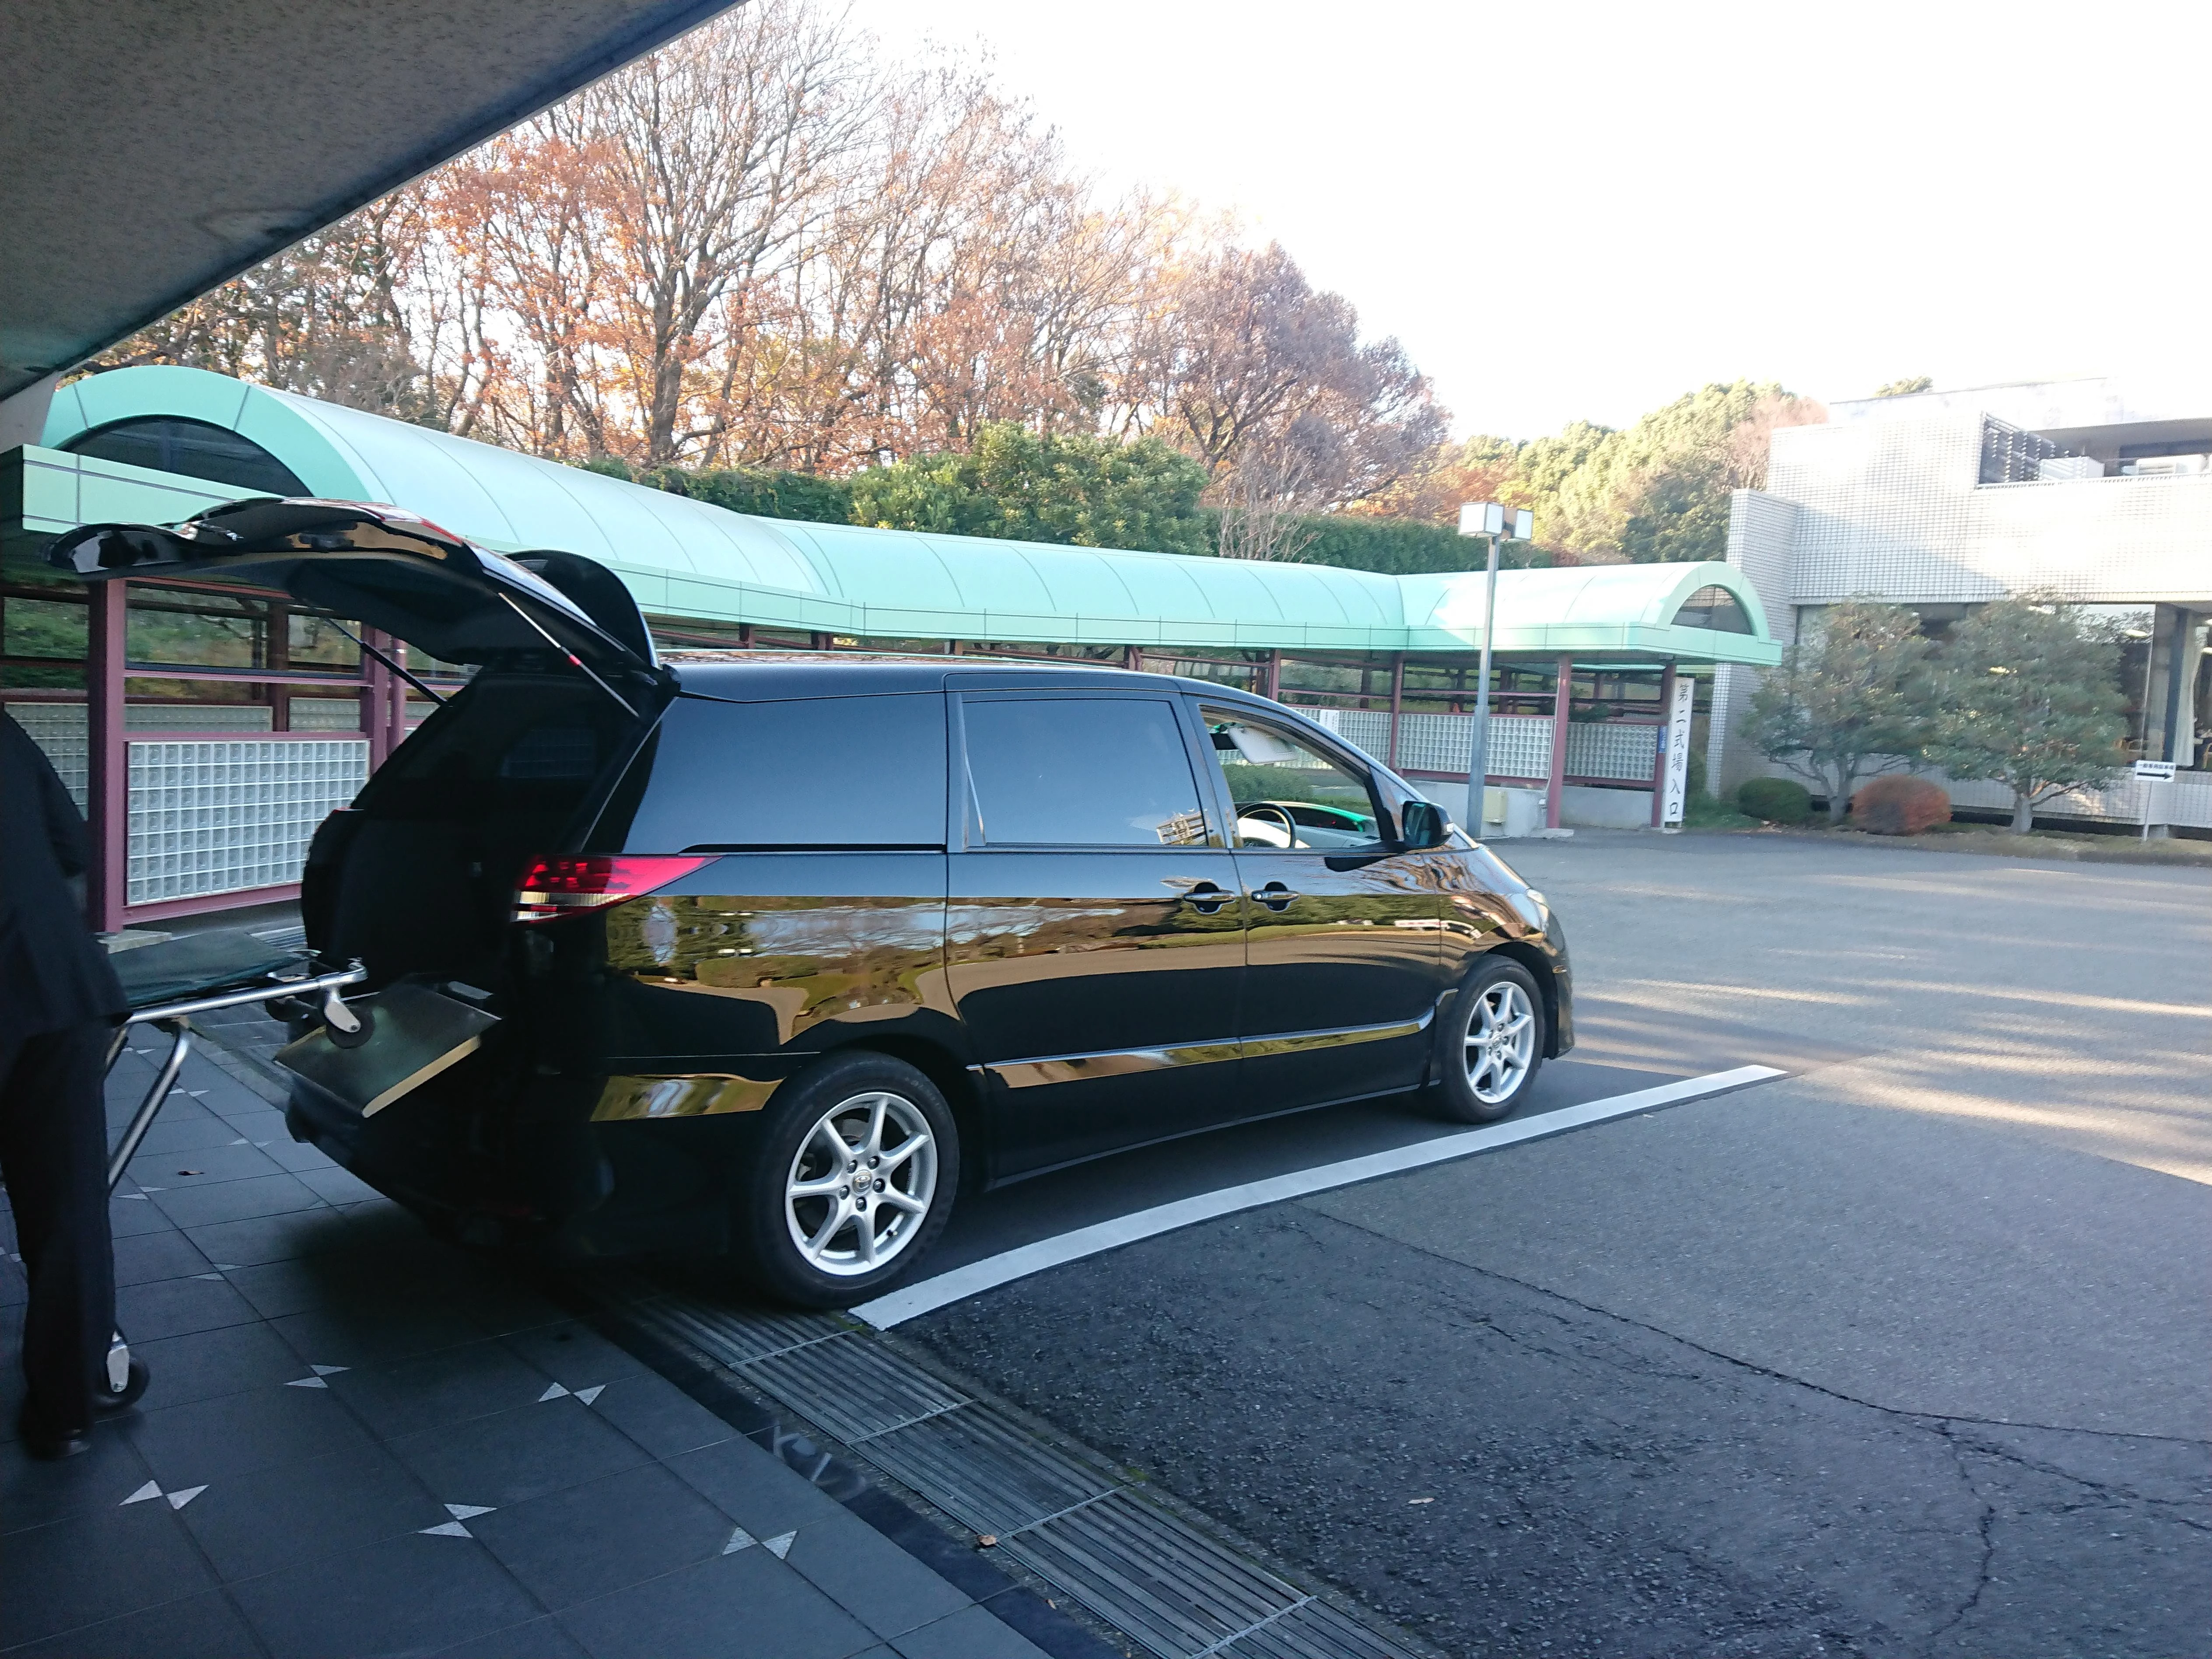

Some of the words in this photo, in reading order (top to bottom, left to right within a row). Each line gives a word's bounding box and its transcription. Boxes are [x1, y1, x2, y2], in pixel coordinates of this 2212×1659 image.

[1670, 683, 1690, 816] 第二式場入口
